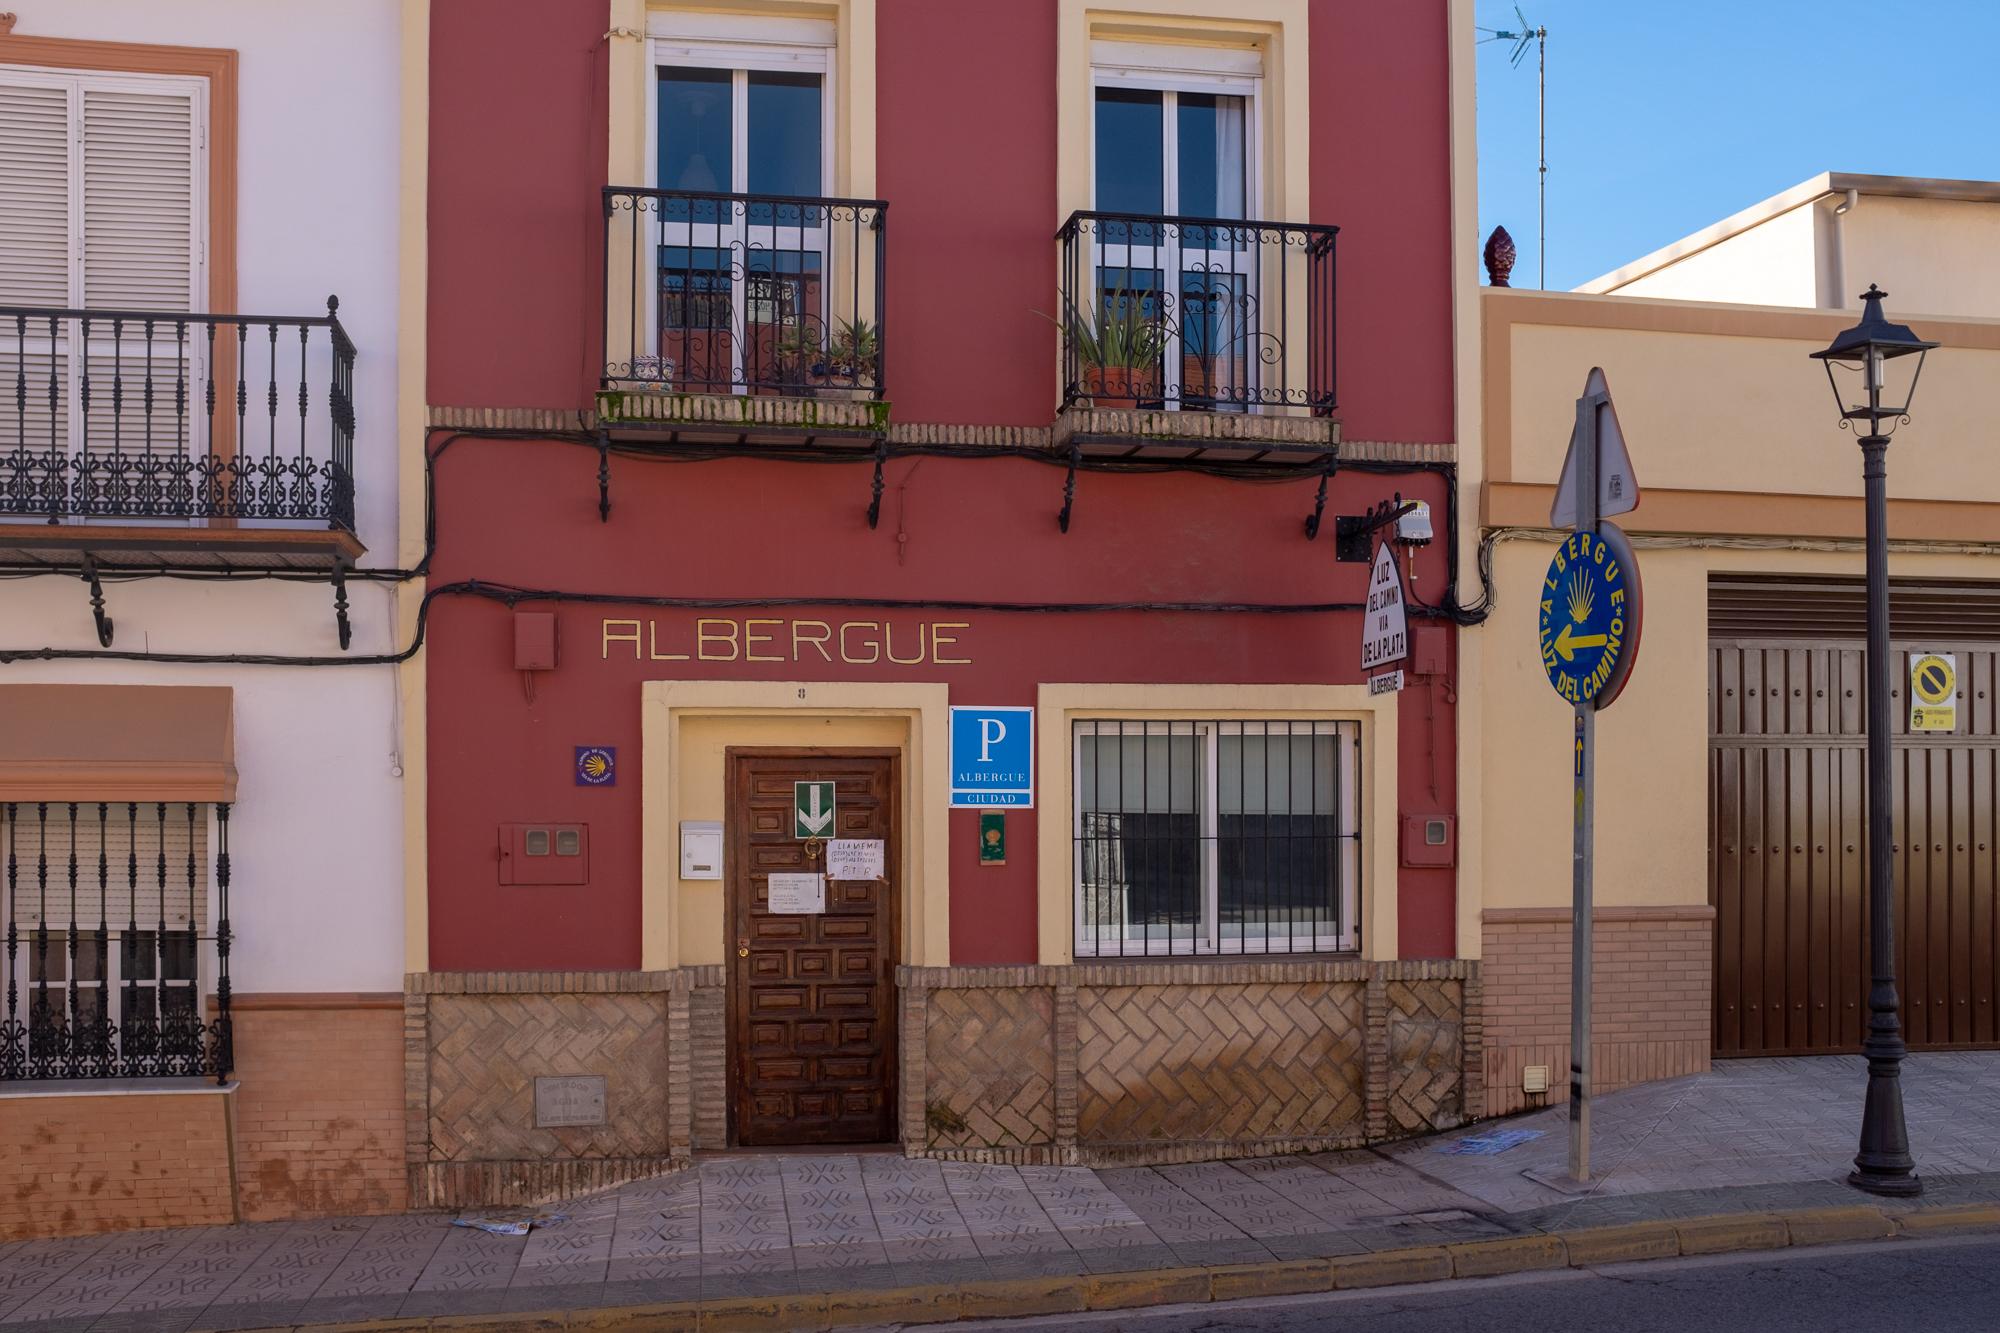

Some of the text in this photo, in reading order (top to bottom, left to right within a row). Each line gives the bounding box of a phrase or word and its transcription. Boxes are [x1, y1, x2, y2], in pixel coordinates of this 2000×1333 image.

[1376, 562, 1390, 584] LUZ
[1541, 533, 1625, 616] ALBERGUE
[1369, 586, 1398, 612] DEL CAMINO
[602, 618, 973, 665] ALBERGUE
[1364, 632, 1404, 663] DE LA PLATA
[1541, 617, 1624, 702] LUZ DEL CAMINO
[797, 688, 806, 699] 8
[1370, 675, 1398, 696] ALBERGUE
[977, 718, 1007, 762] P
[958, 772, 1026, 782] ALBERGUE
[967, 794, 1016, 804] CIUDAD
